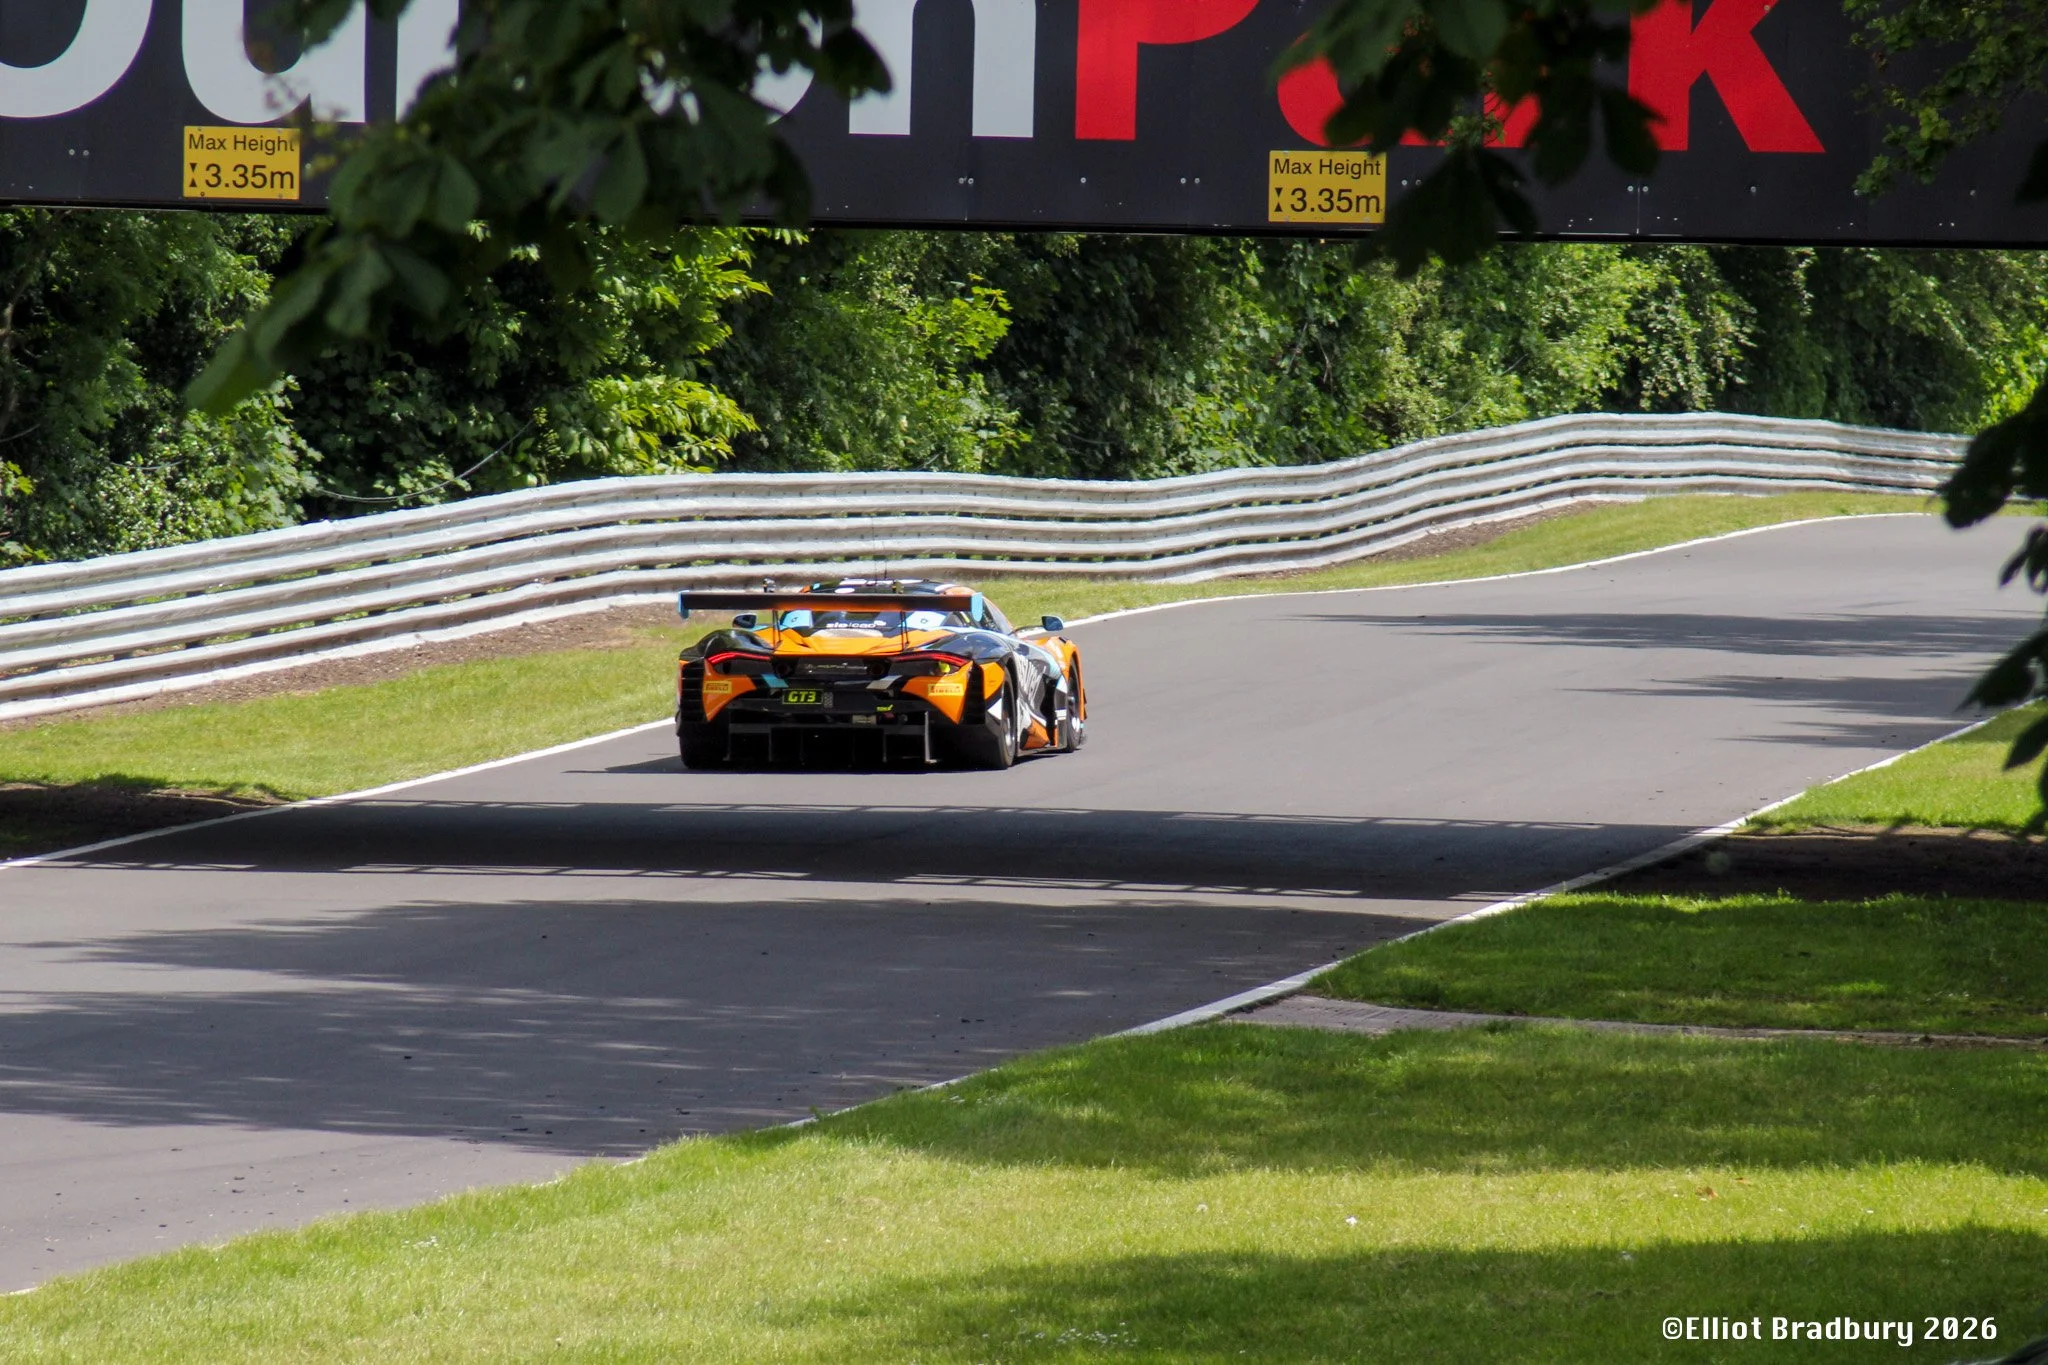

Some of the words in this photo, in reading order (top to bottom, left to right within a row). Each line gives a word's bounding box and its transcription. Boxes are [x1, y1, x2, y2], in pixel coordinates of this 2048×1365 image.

[189, 133, 227, 151] Max
[233, 134, 294, 155] Height
[205, 163, 294, 189] 3.35m
[1274, 158, 1312, 175] Max
[1319, 159, 1381, 180] Height
[1290, 187, 1380, 213] 3.35m
[788, 690, 817, 703] GT3
